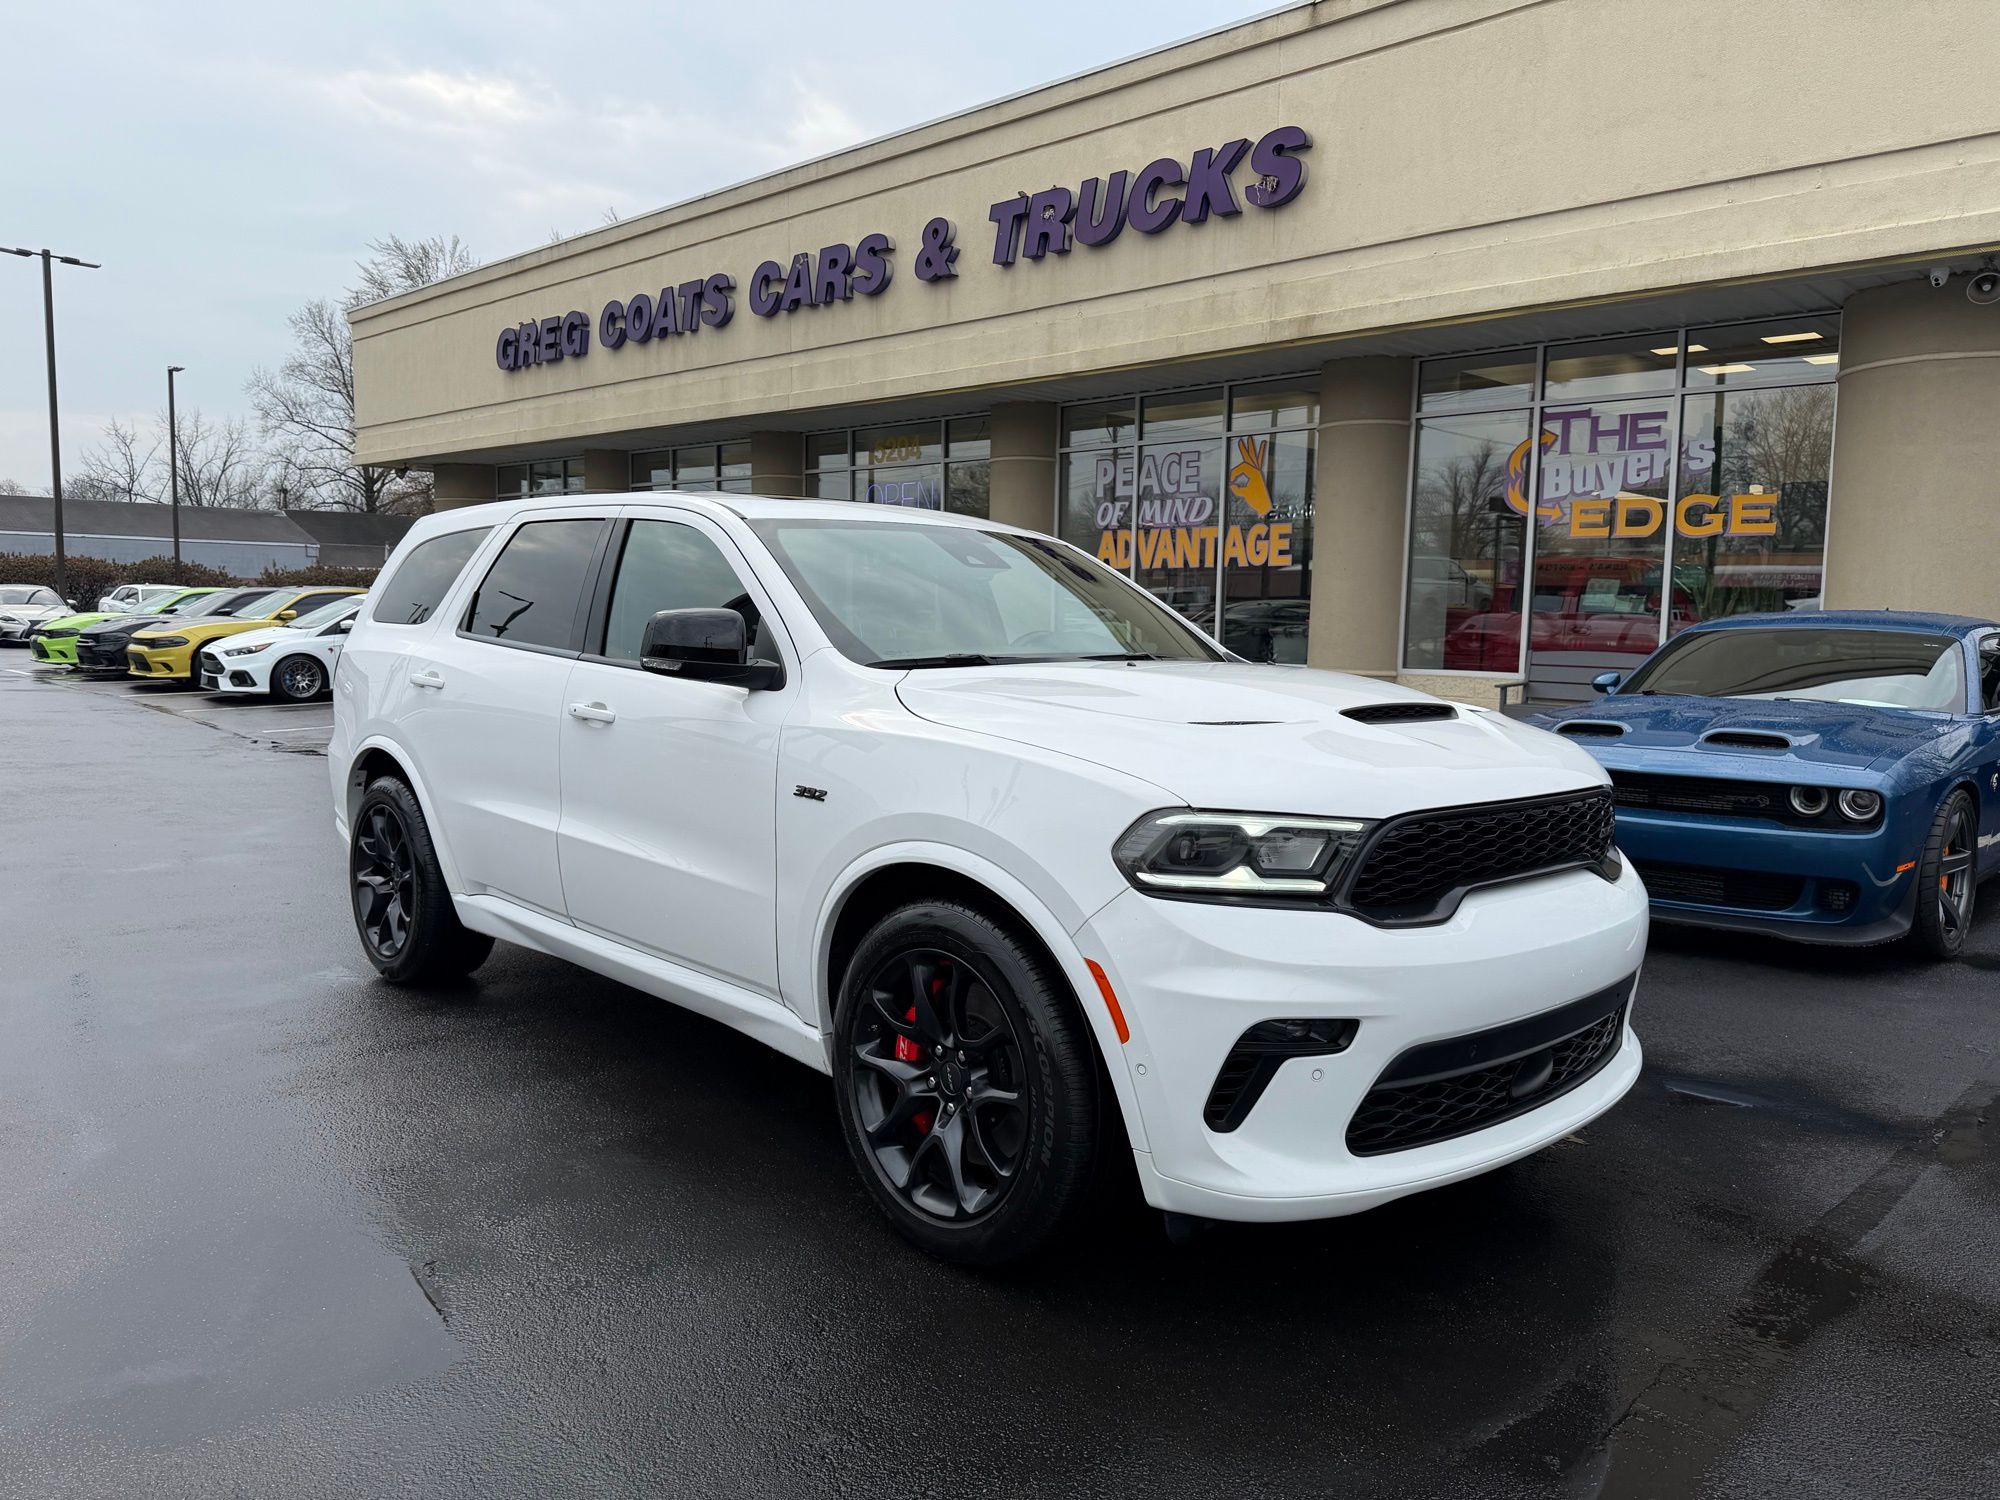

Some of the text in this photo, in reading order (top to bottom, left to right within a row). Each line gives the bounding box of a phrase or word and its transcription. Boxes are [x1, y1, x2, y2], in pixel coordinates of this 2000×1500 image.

[496, 125, 1313, 371] GREG COATS CARS & TRUCKS
[874, 436, 921, 465] 5204
[1542, 408, 1668, 455] THE
[1096, 451, 1200, 498] PEACE
[1538, 439, 1716, 500] Buyers
[866, 480, 934, 509] OPEN
[1096, 497, 1214, 529] OF MIND
[1570, 493, 1777, 538] EDGE
[1097, 523, 1293, 570] ADVANTAGE
[793, 785, 827, 802] 392
[1026, 1016, 1055, 1169] SCORPION
